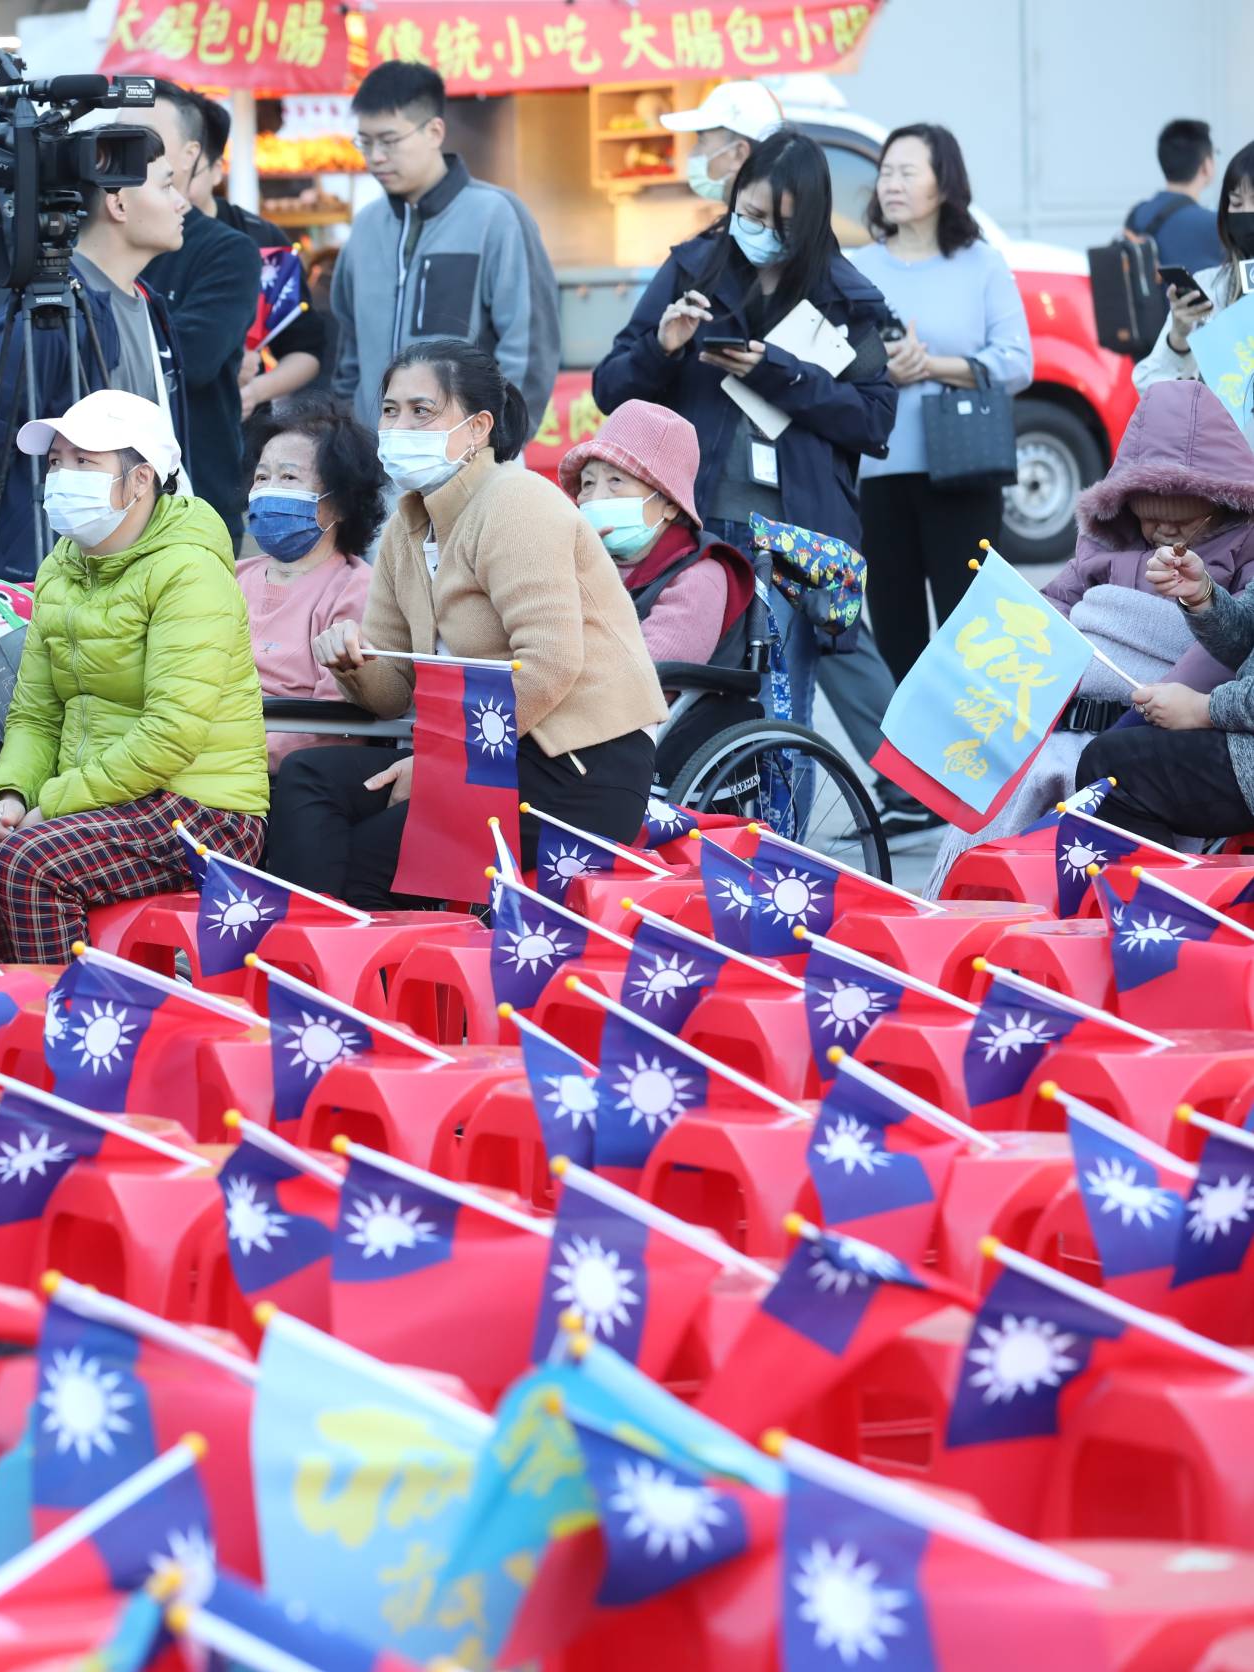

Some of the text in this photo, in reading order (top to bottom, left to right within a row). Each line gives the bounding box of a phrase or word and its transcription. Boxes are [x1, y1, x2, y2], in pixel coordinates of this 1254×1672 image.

[376, 13, 603, 81] 傳統小吃
[730, 777, 758, 796] KARMA
